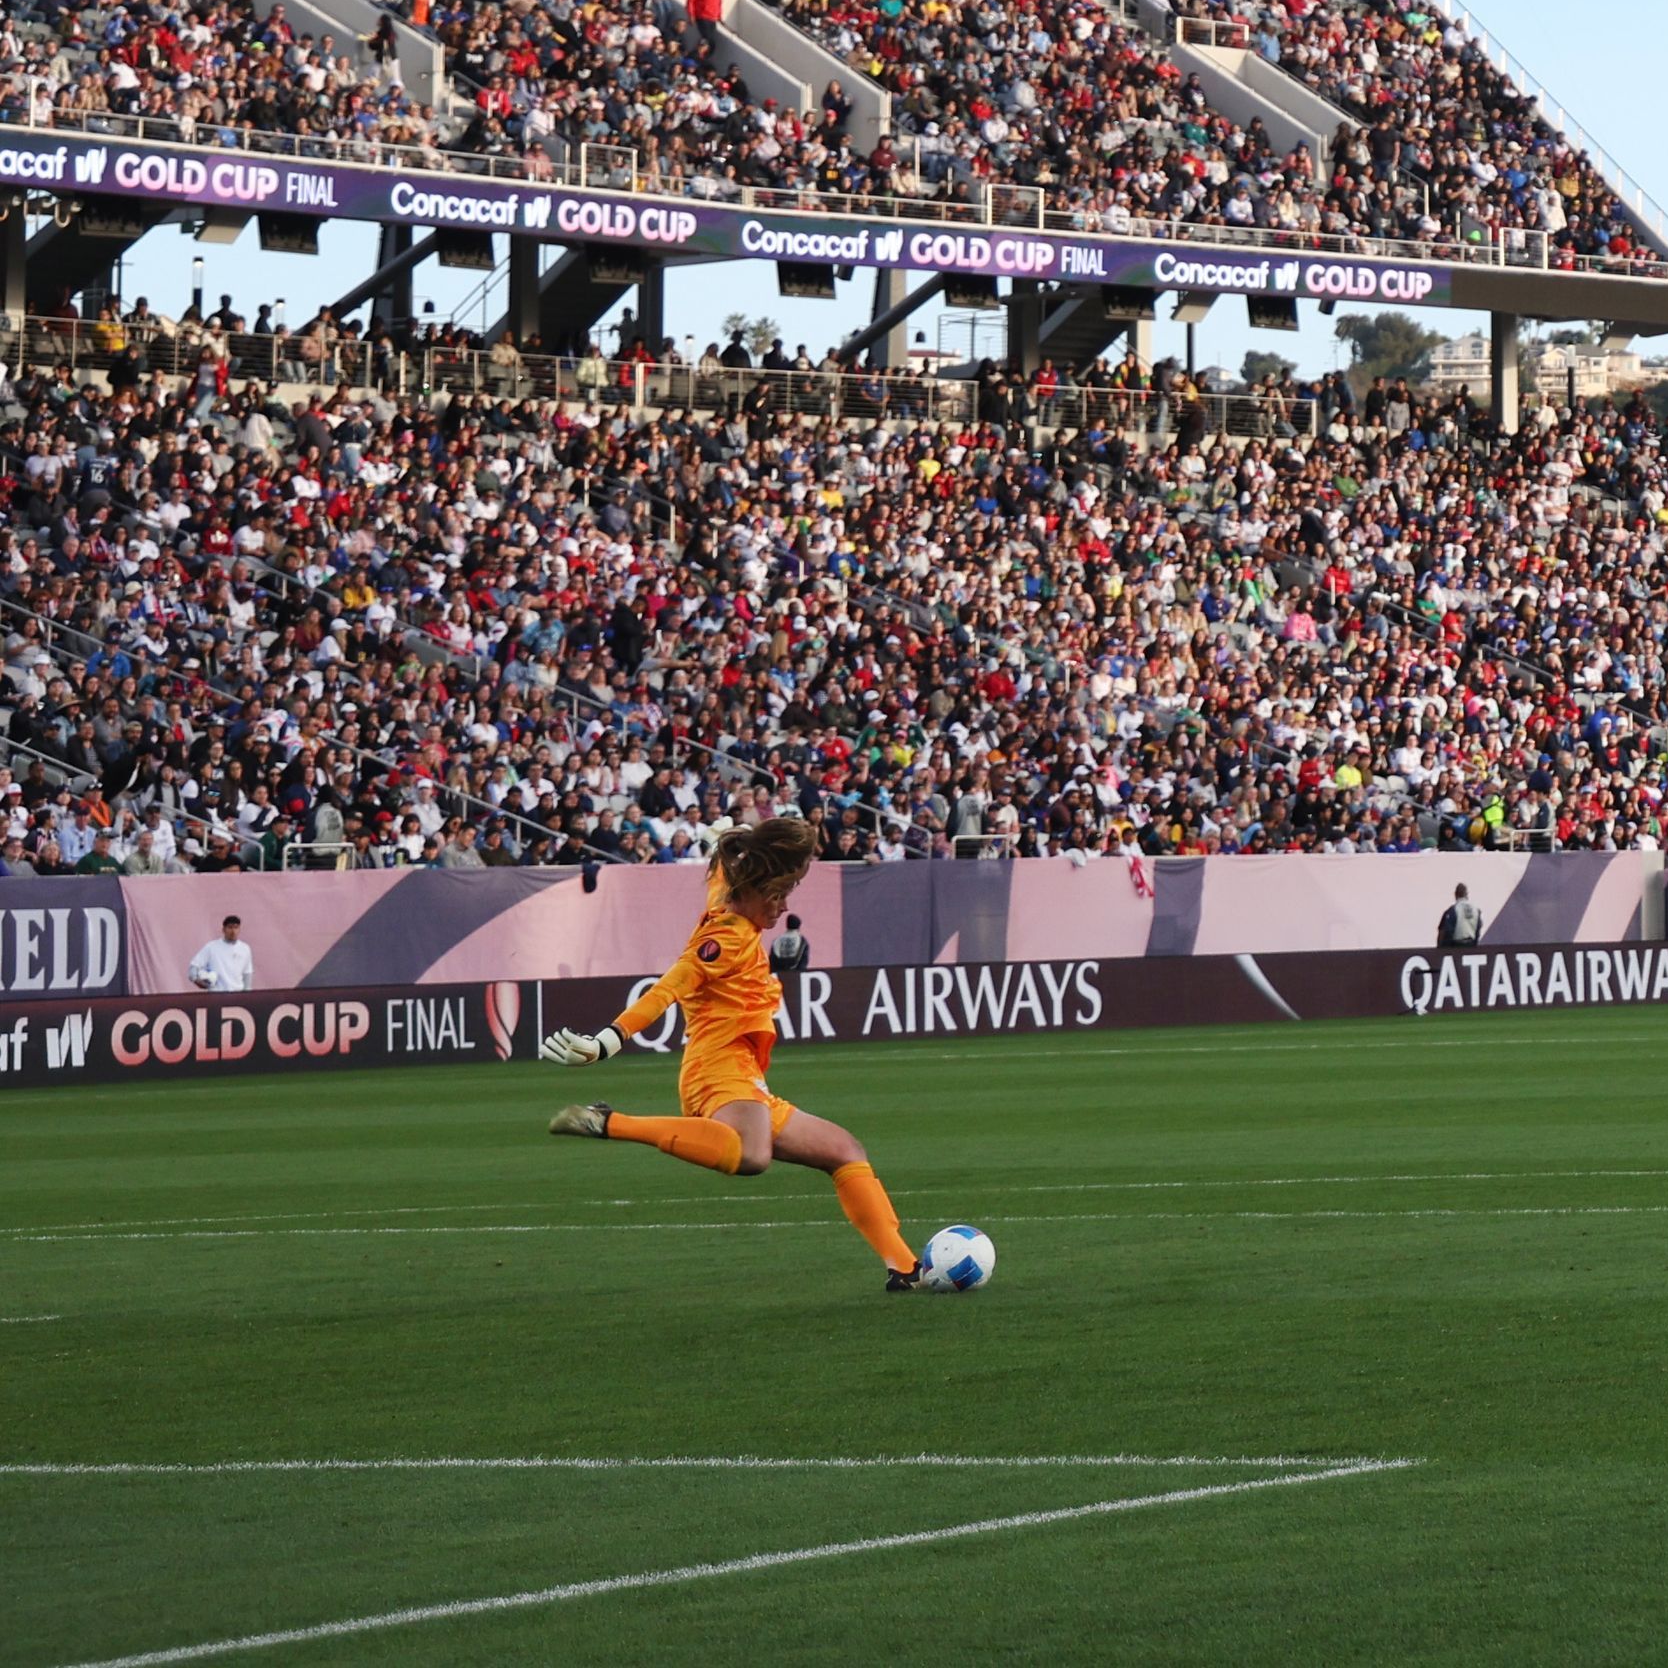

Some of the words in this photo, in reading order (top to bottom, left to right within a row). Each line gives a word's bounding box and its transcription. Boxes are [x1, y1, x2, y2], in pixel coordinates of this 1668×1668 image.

[115, 152, 207, 194] GOLD
[212, 162, 280, 202] CUP
[286, 172, 339, 208] FINAL
[391, 182, 519, 226] Concacaf
[558, 199, 636, 238] GOLD
[639, 208, 697, 243] CUP
[742, 220, 869, 260] Concacaf
[910, 233, 991, 269] GOLD
[995, 240, 1055, 272] CUP
[1060, 246, 1107, 277] FINAL
[1154, 253, 1270, 289] Concacaf
[1305, 263, 1377, 298] GOLD
[1380, 269, 1433, 300] CUP
[862, 961, 1102, 1035] AIRWAYS
[111, 1005, 256, 1067] GOLD
[267, 1001, 371, 1058] CUP
[386, 996, 476, 1053] FINAL
